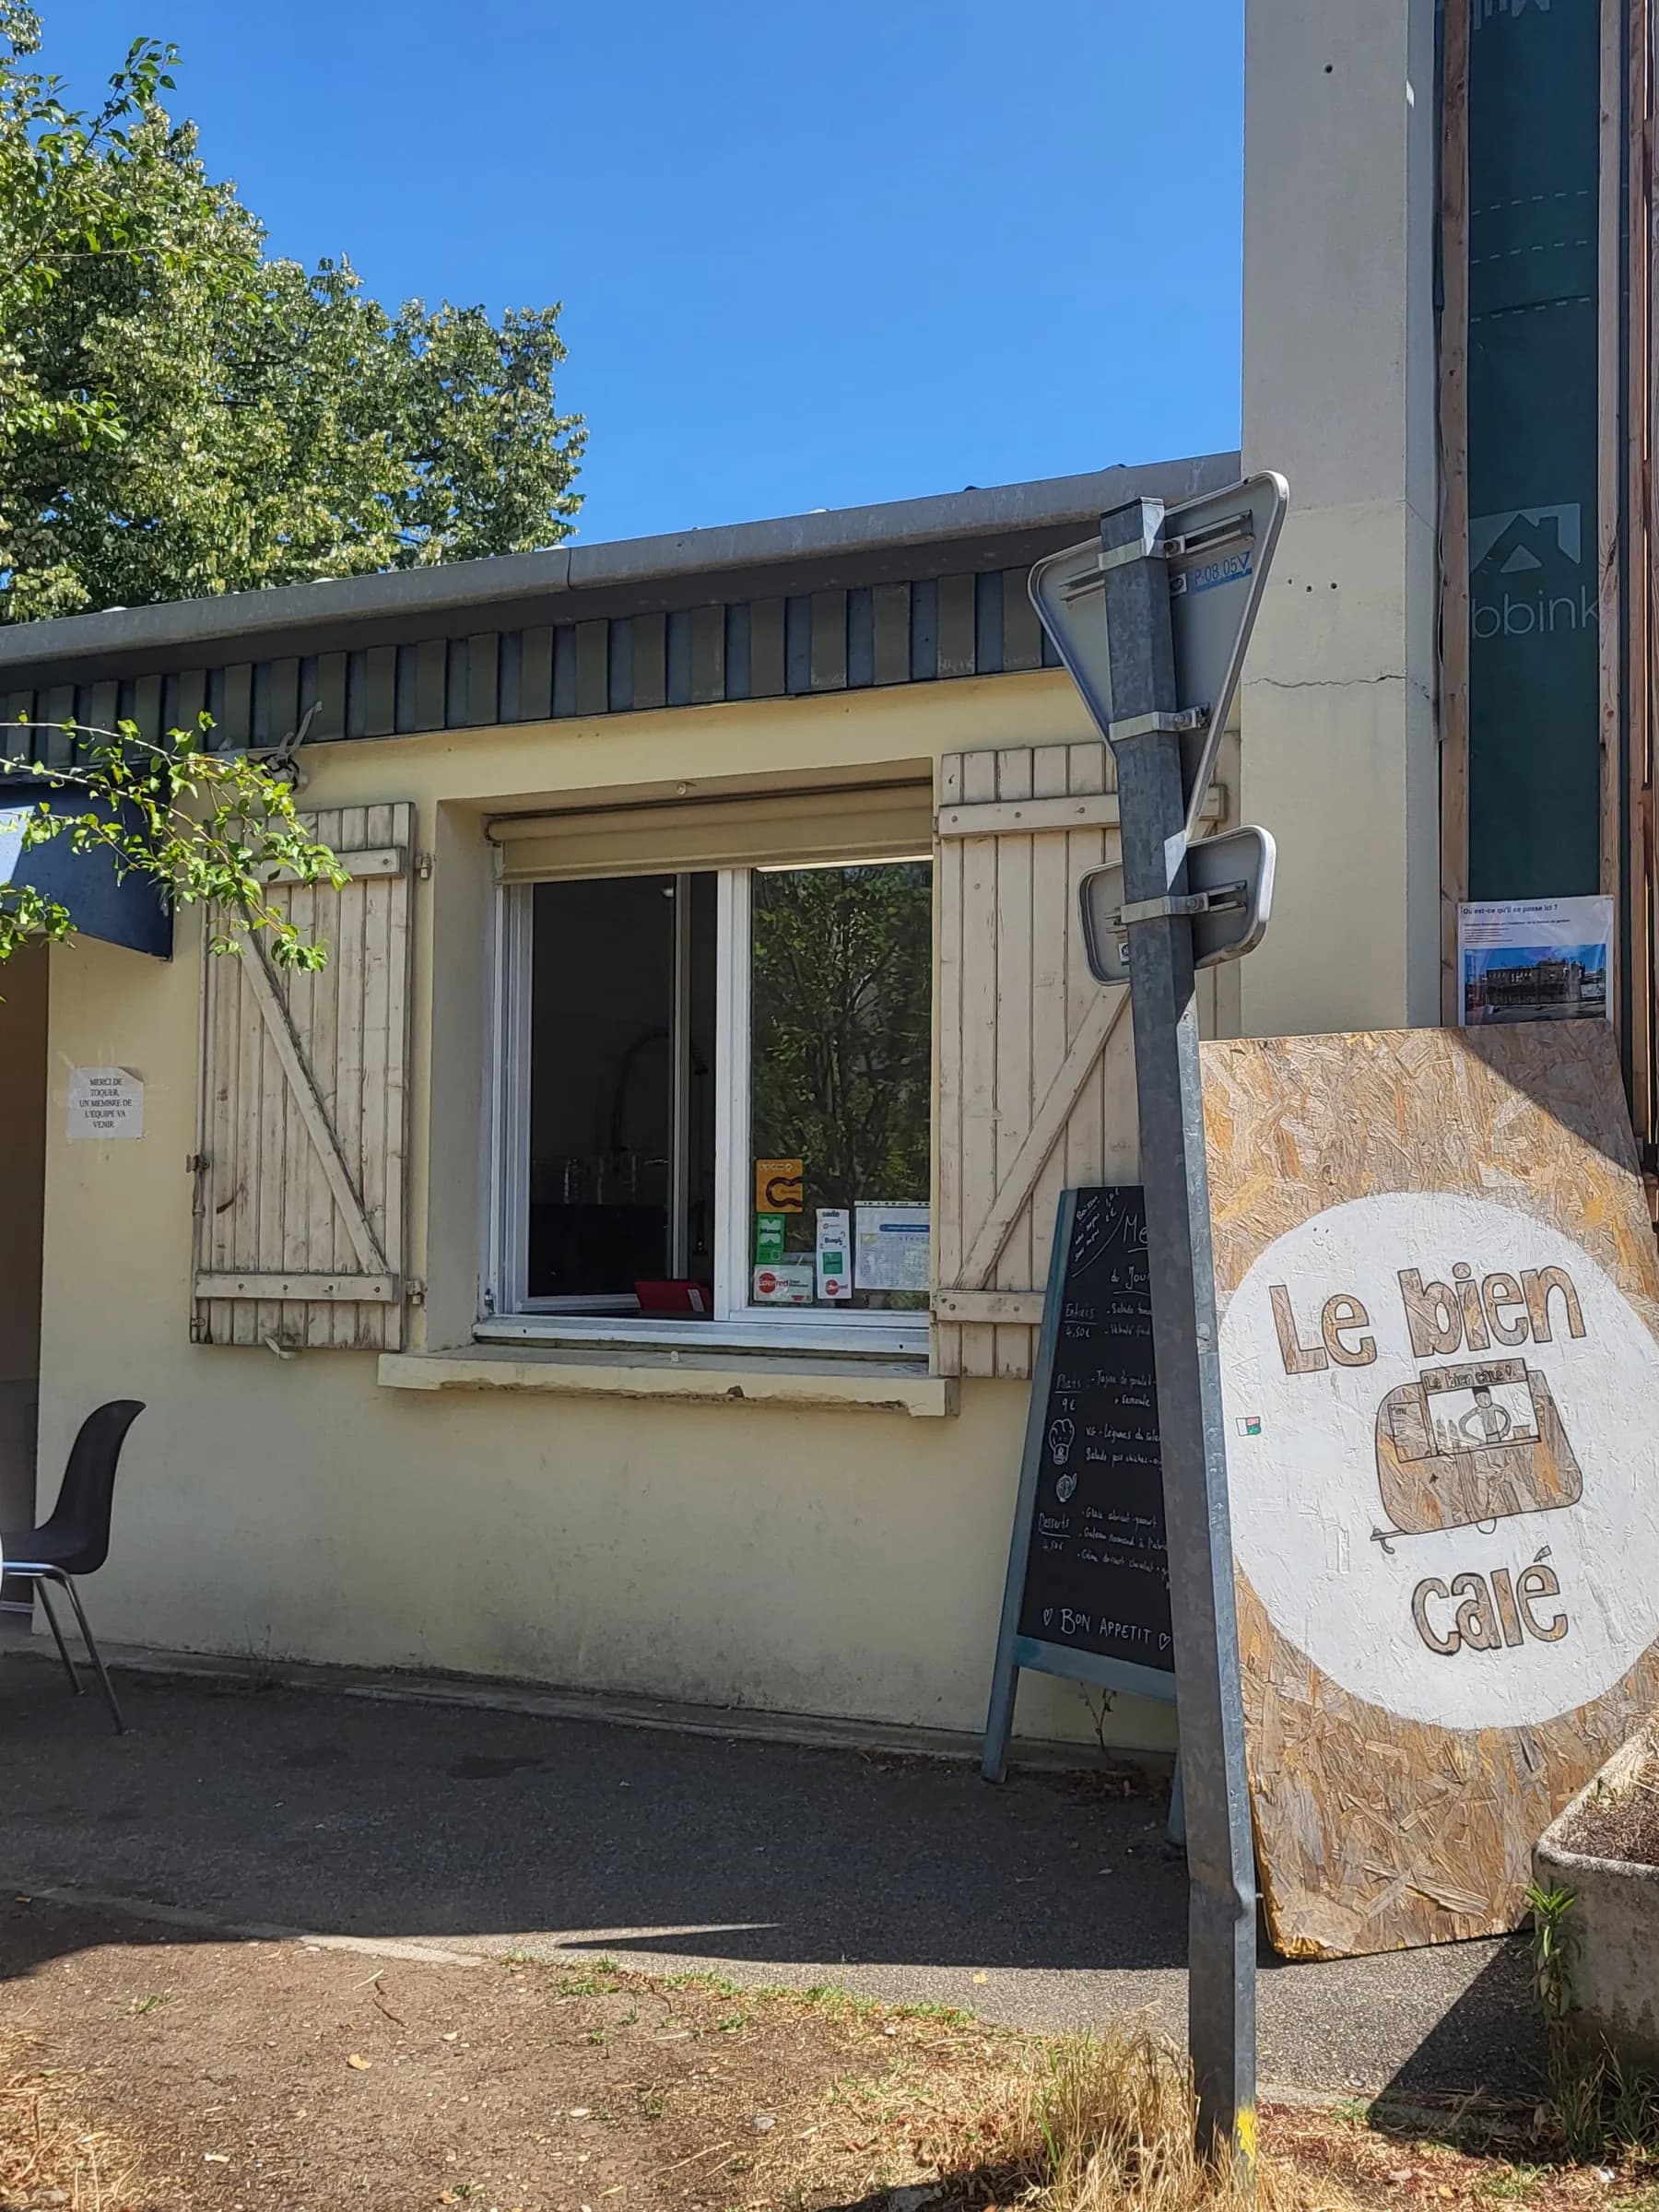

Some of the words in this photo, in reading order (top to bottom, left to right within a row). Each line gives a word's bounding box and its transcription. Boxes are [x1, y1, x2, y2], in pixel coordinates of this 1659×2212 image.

[1471, 584, 1599, 640] bbink
[89, 1077, 112, 1086] MERCI
[112, 1077, 123, 1086] DE
[90, 1099, 122, 1107] MEMBRE
[123, 1099, 133, 1107] DE
[117, 1109, 126, 1118] VA
[92, 1121, 115, 1129] VENIR
[1123, 1212, 1149, 1246] Me
[1269, 1284, 1377, 1374] Le
[1397, 1262, 1586, 1358] bien
[1423, 1374, 1441, 1391] Le
[1444, 1372, 1475, 1389] bien
[1411, 1545, 1570, 1656] calé
[1099, 1617, 1153, 1644] APPETIT
